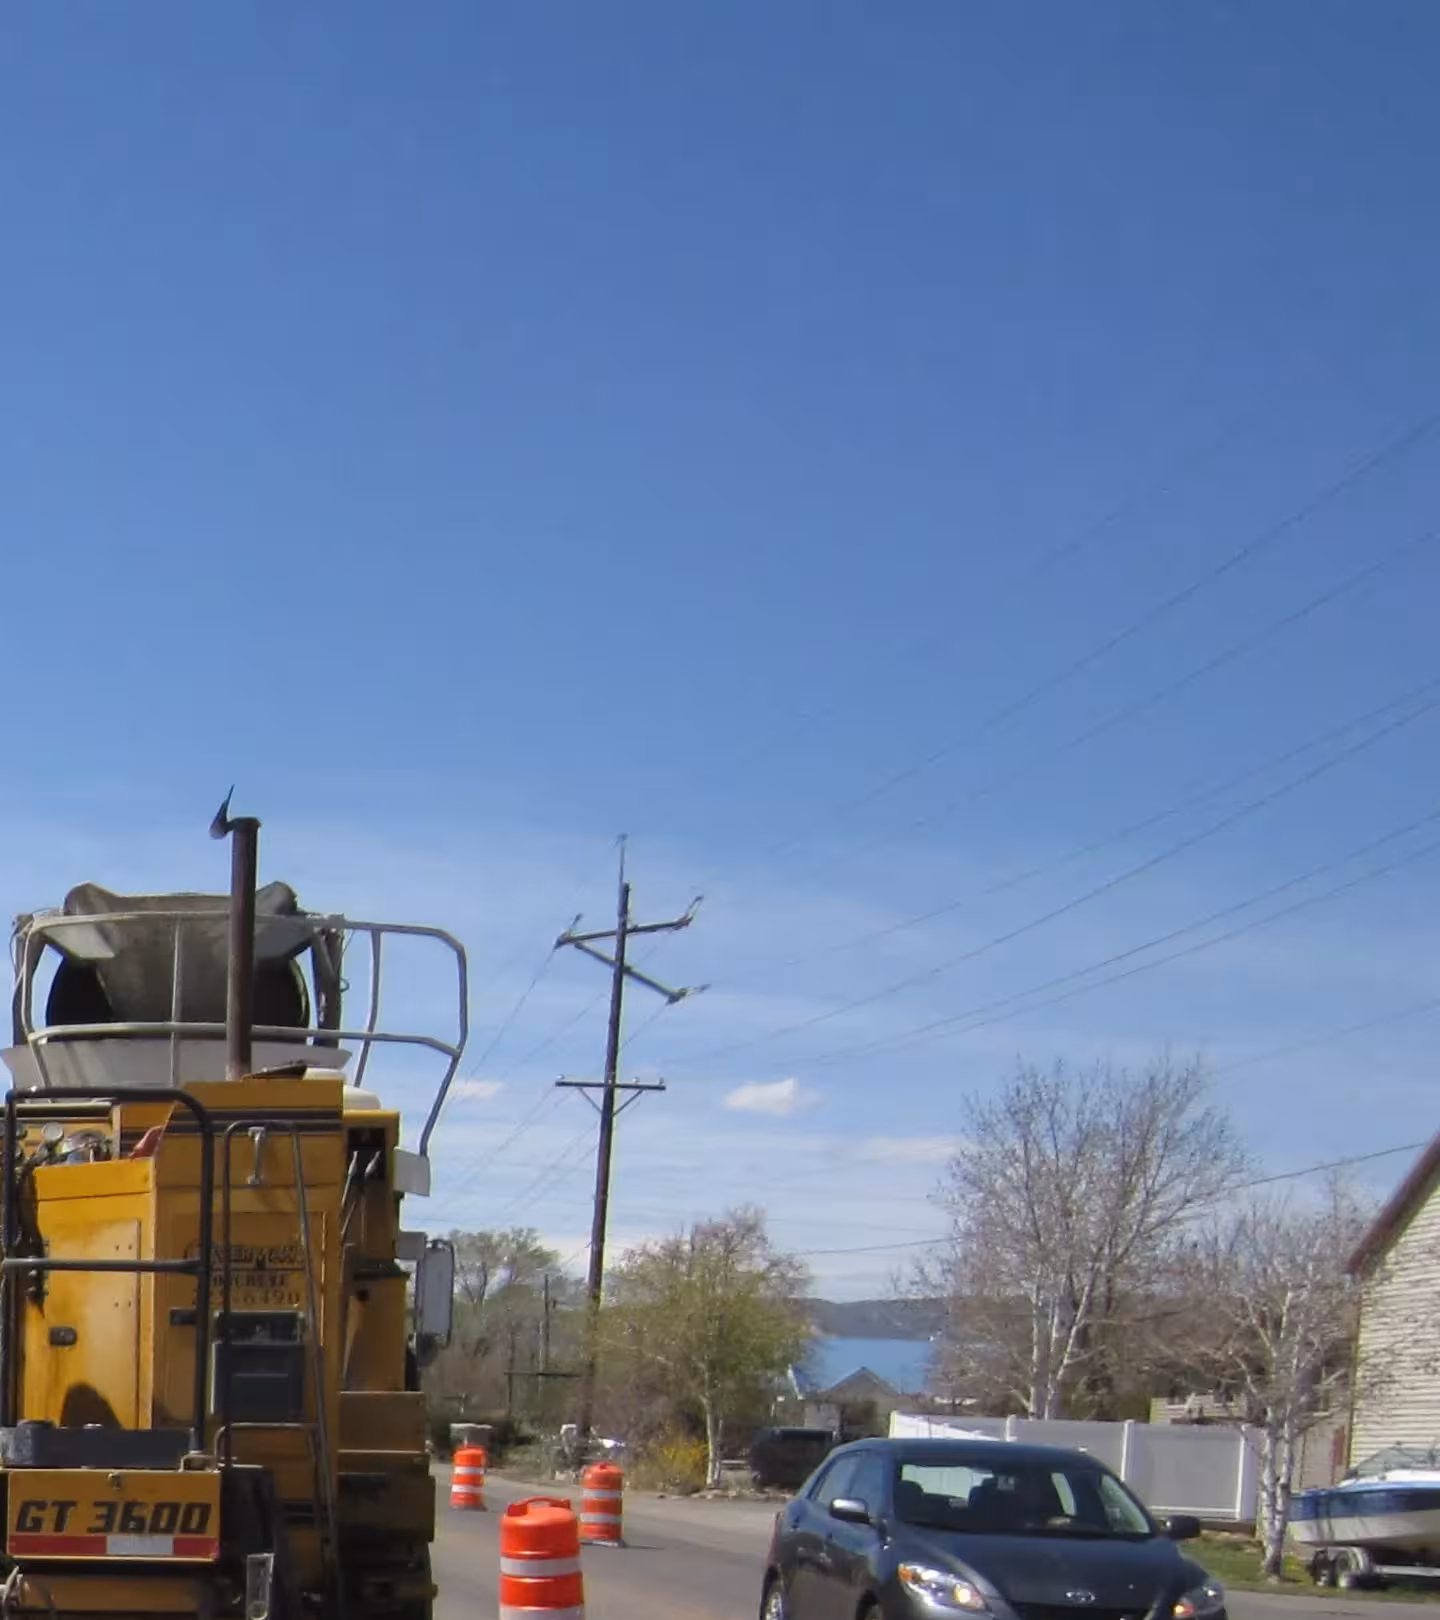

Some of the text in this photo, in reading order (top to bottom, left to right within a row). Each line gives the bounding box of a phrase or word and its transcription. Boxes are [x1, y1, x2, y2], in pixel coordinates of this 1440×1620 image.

[207, 1272, 286, 1288] OCRETE
[16, 1501, 212, 1534] GT 3600
